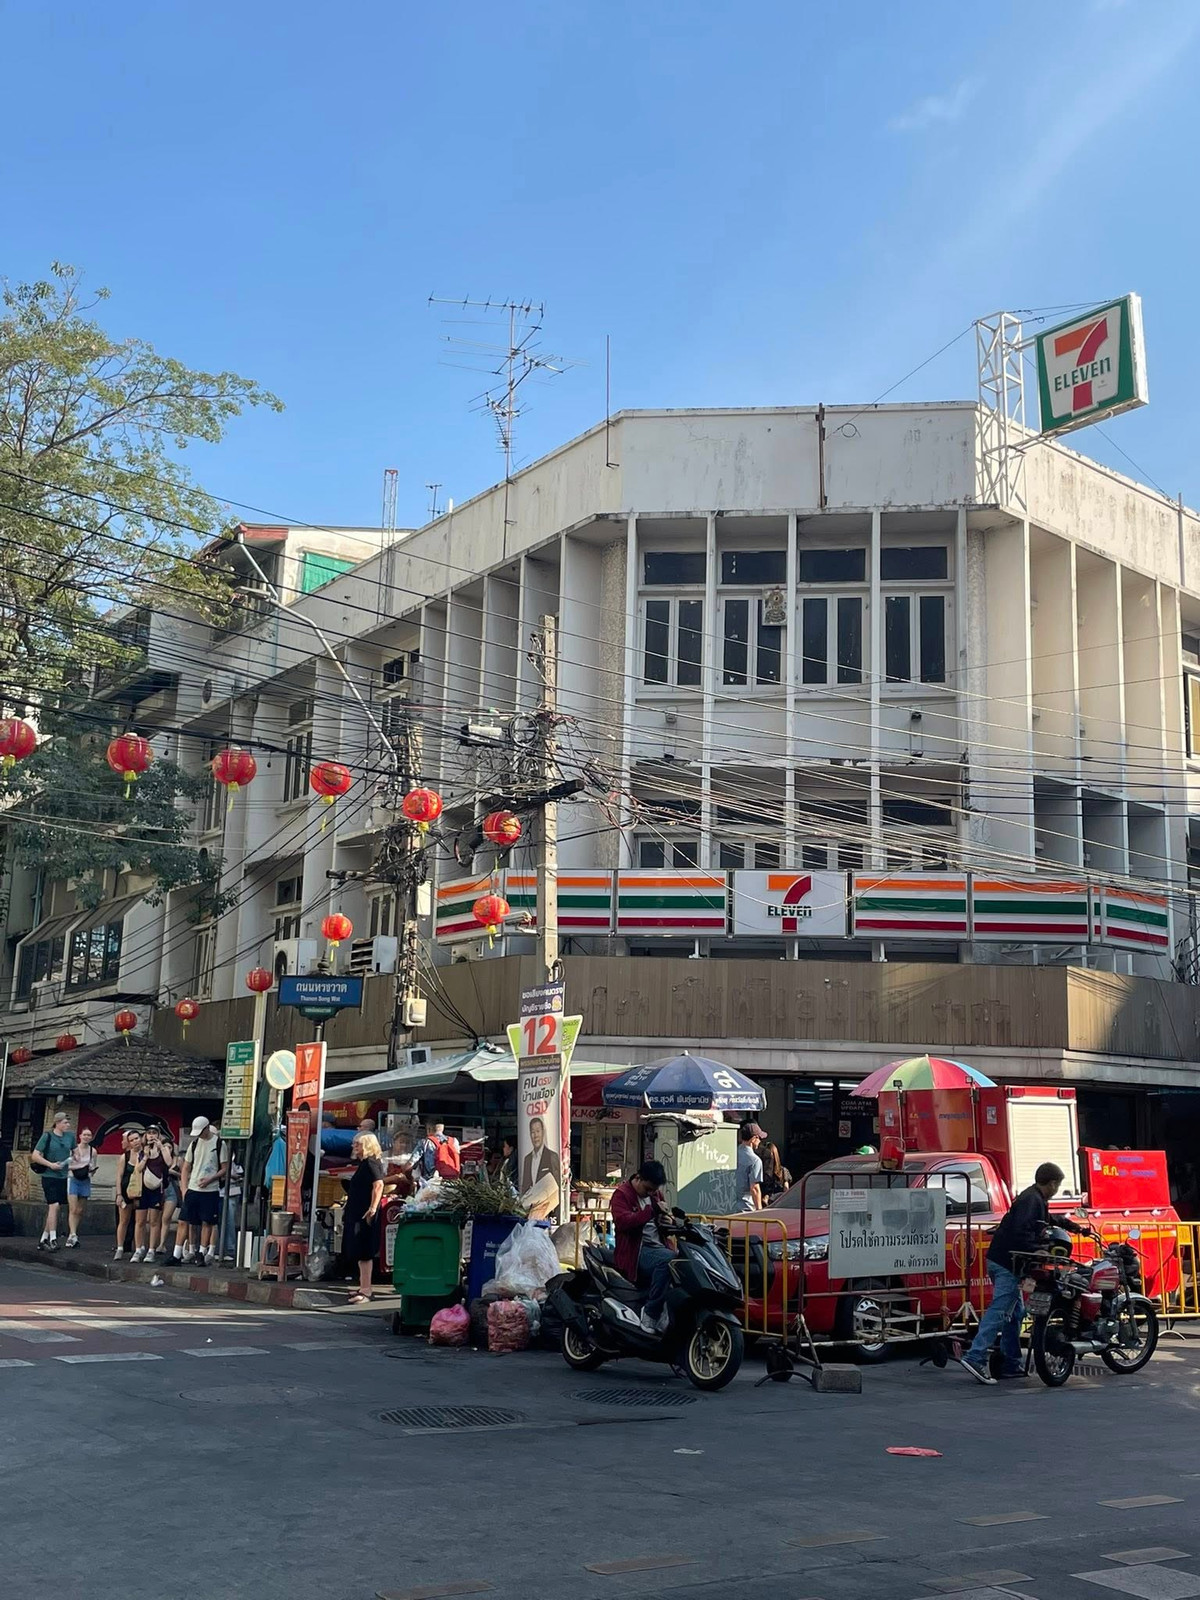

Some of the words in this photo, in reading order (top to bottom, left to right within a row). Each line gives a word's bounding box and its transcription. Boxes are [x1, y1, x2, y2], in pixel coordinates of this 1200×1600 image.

[524, 1015, 557, 1056] 12
[840, 1227, 939, 1249] โปรดใช้ความระมัดระวัง
